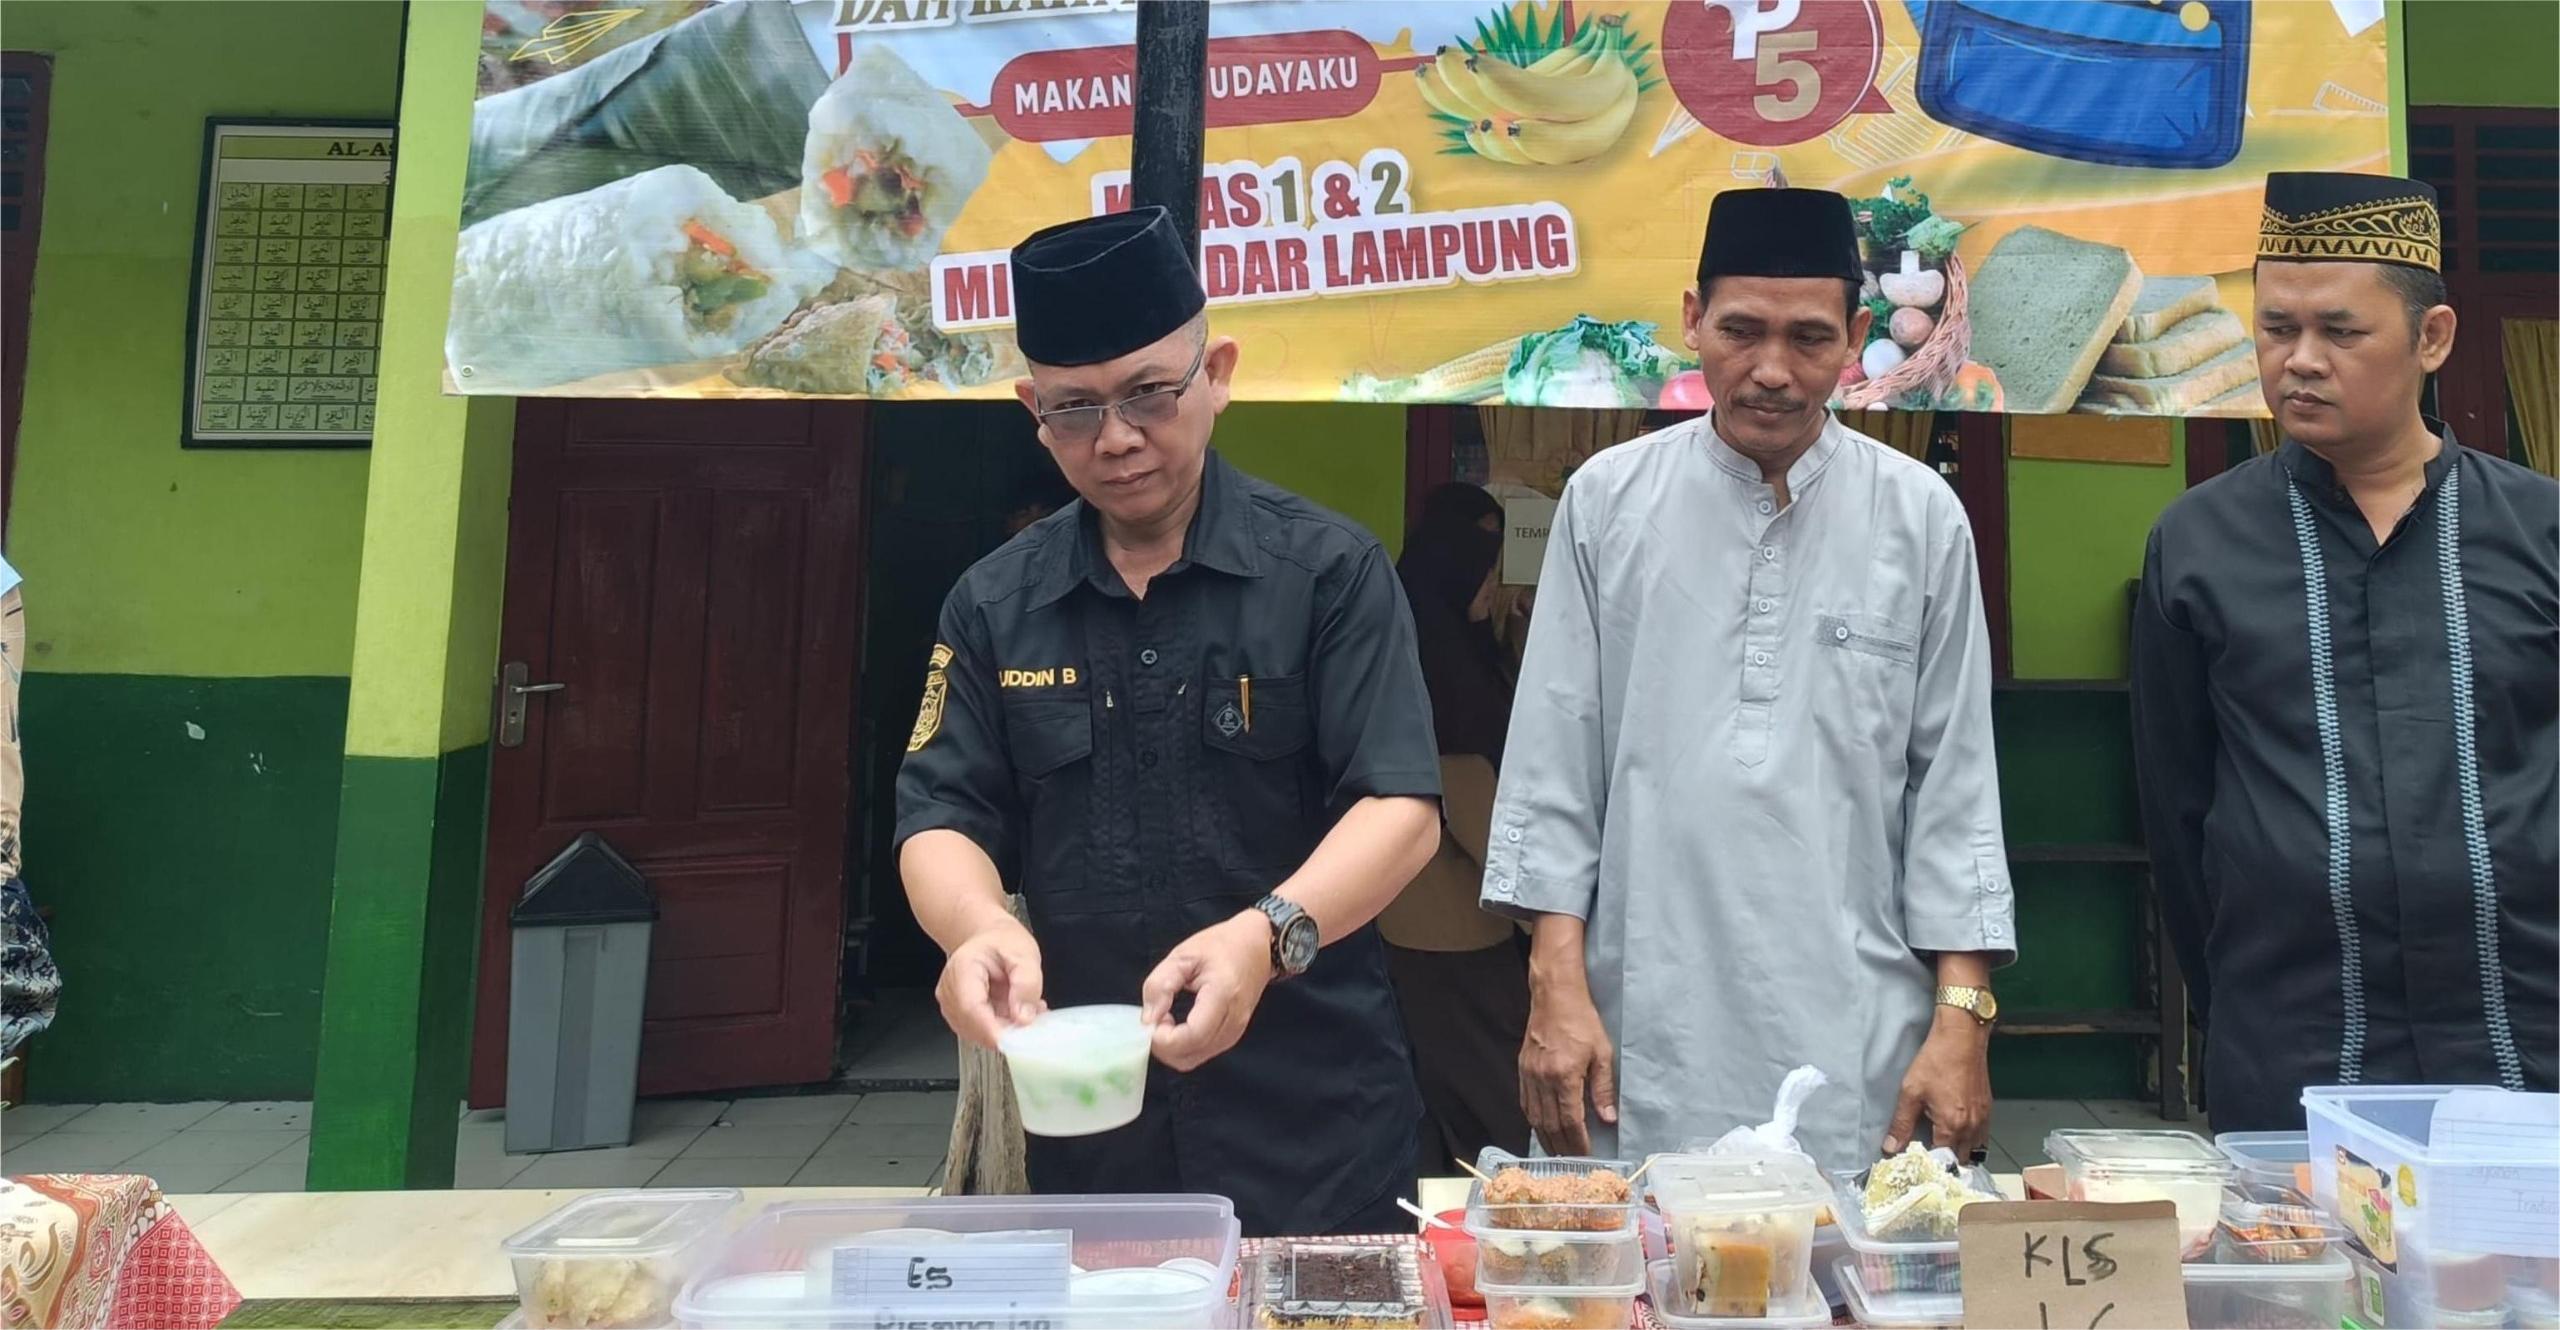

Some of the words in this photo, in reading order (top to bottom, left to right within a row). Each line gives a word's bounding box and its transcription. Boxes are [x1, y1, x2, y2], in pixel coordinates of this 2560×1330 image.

[1015, 74, 1132, 115] MAKAN
[1209, 56, 1358, 99] UDAYAKU
[327, 141, 391, 156] AL-A
[1272, 170, 1298, 223] 1
[1323, 173, 1361, 219] &
[1371, 161, 1404, 215] 2
[1205, 237, 1311, 299] DAR
[1322, 214, 1570, 288] LAMPUNG
[1514, 527, 1550, 539] TEMP
[998, 668, 1055, 688] UDDIN
[1062, 667, 1077, 685] B
[2024, 1231, 2118, 1286] KLS
